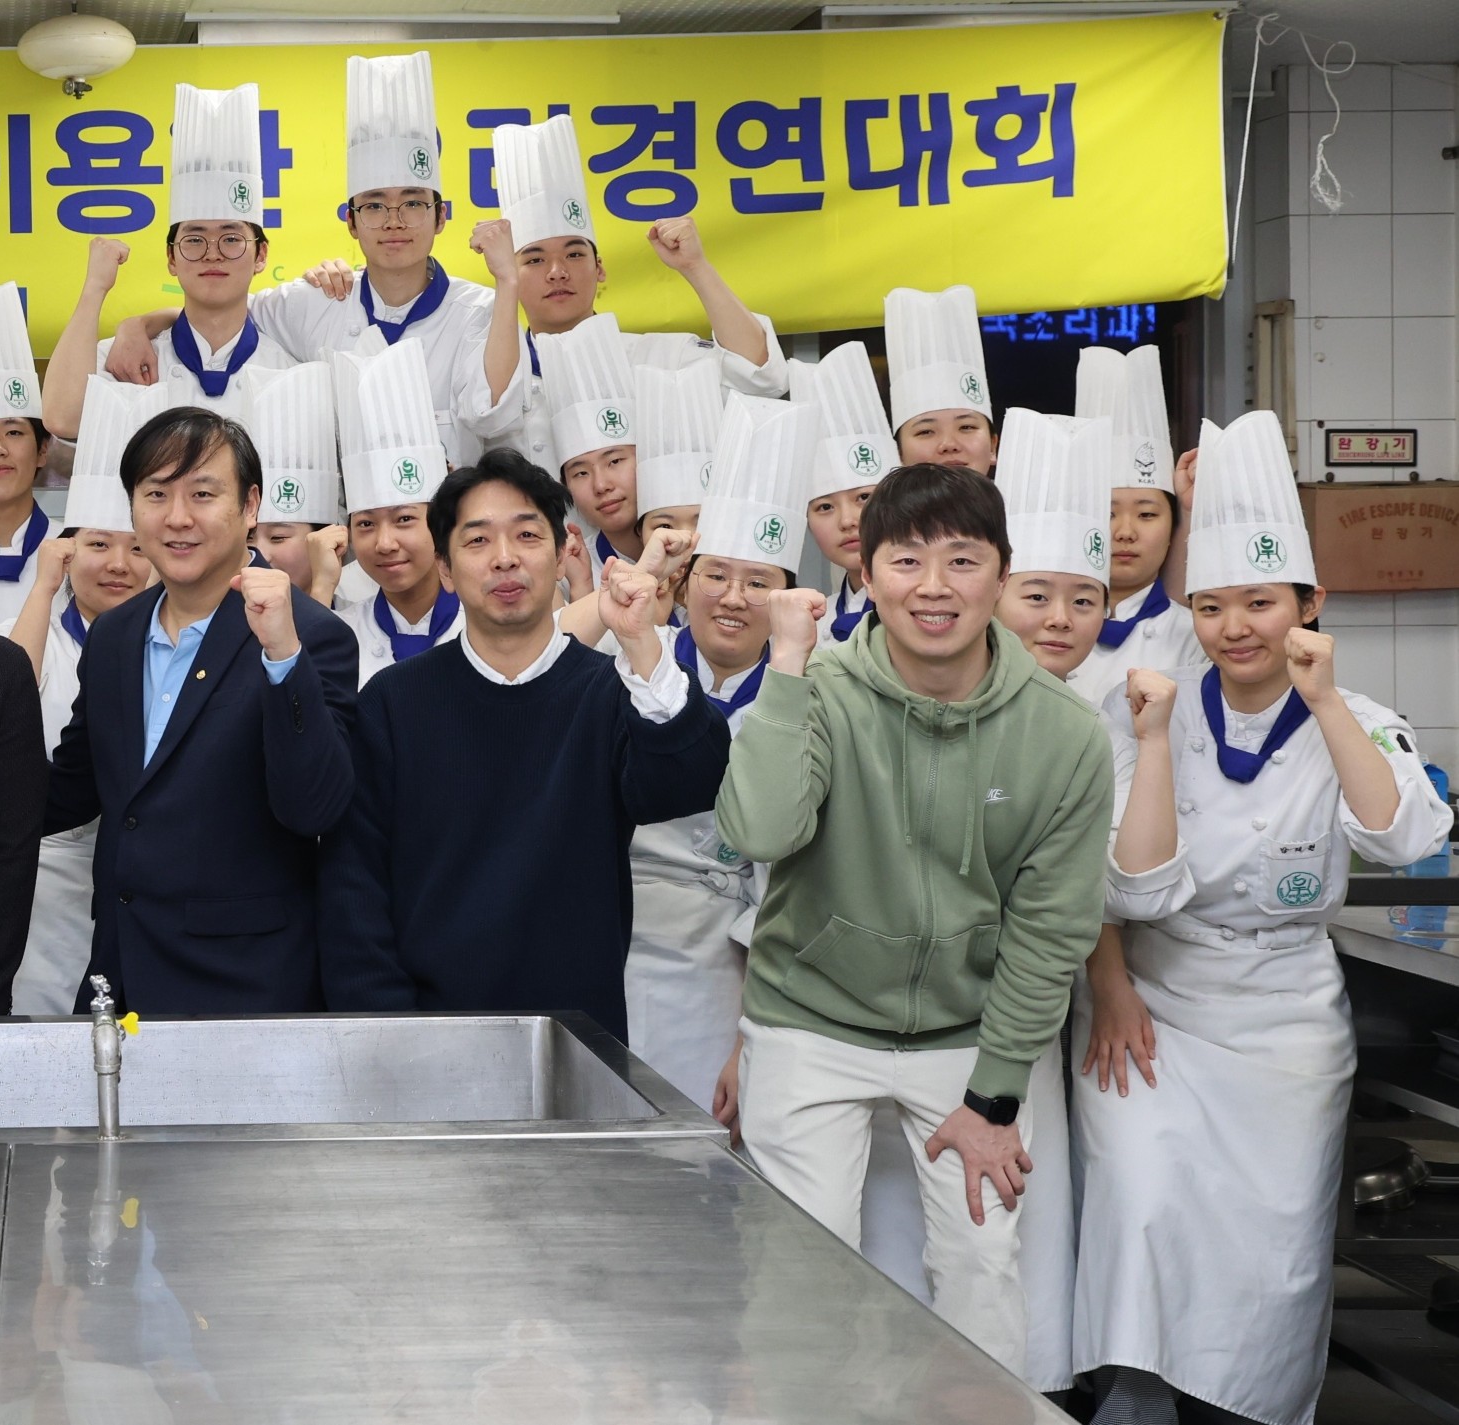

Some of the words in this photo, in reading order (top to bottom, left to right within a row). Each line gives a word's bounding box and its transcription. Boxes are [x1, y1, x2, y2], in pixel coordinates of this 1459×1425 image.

[339, 83, 1076, 222] 경연대회
[1338, 507, 1367, 529] FIRE
[1369, 502, 1415, 519] ESCAPE
[1419, 503, 1459, 526] DEVICE
